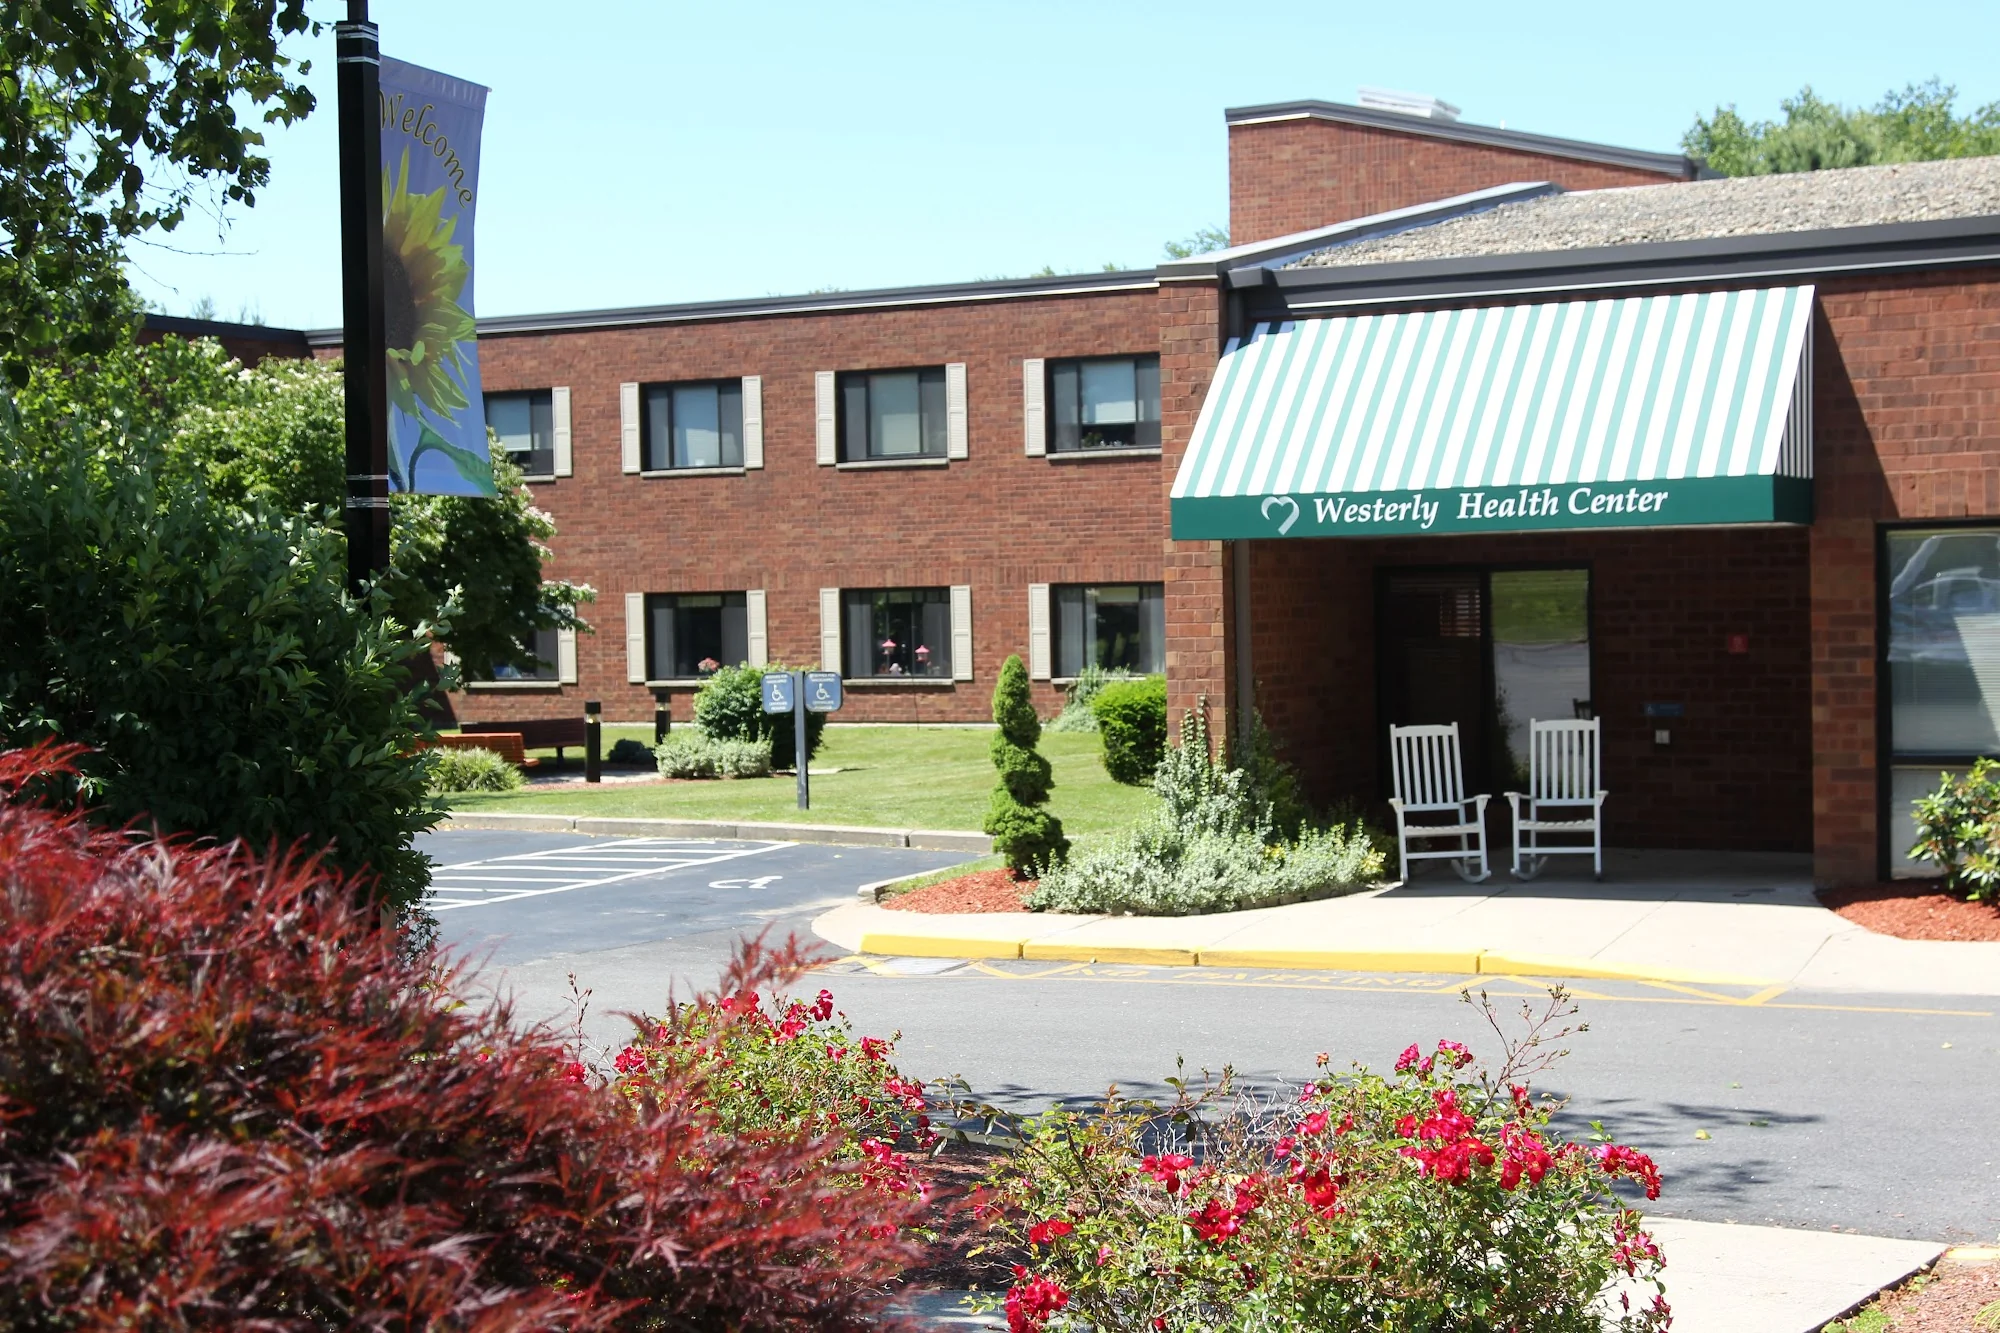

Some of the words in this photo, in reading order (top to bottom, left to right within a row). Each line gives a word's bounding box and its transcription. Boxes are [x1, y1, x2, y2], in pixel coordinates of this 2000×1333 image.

[379, 90, 473, 208] Welcome
[1313, 494, 1440, 529] Westerly
[1456, 487, 1560, 520] Health
[1567, 486, 1669, 516] Center
